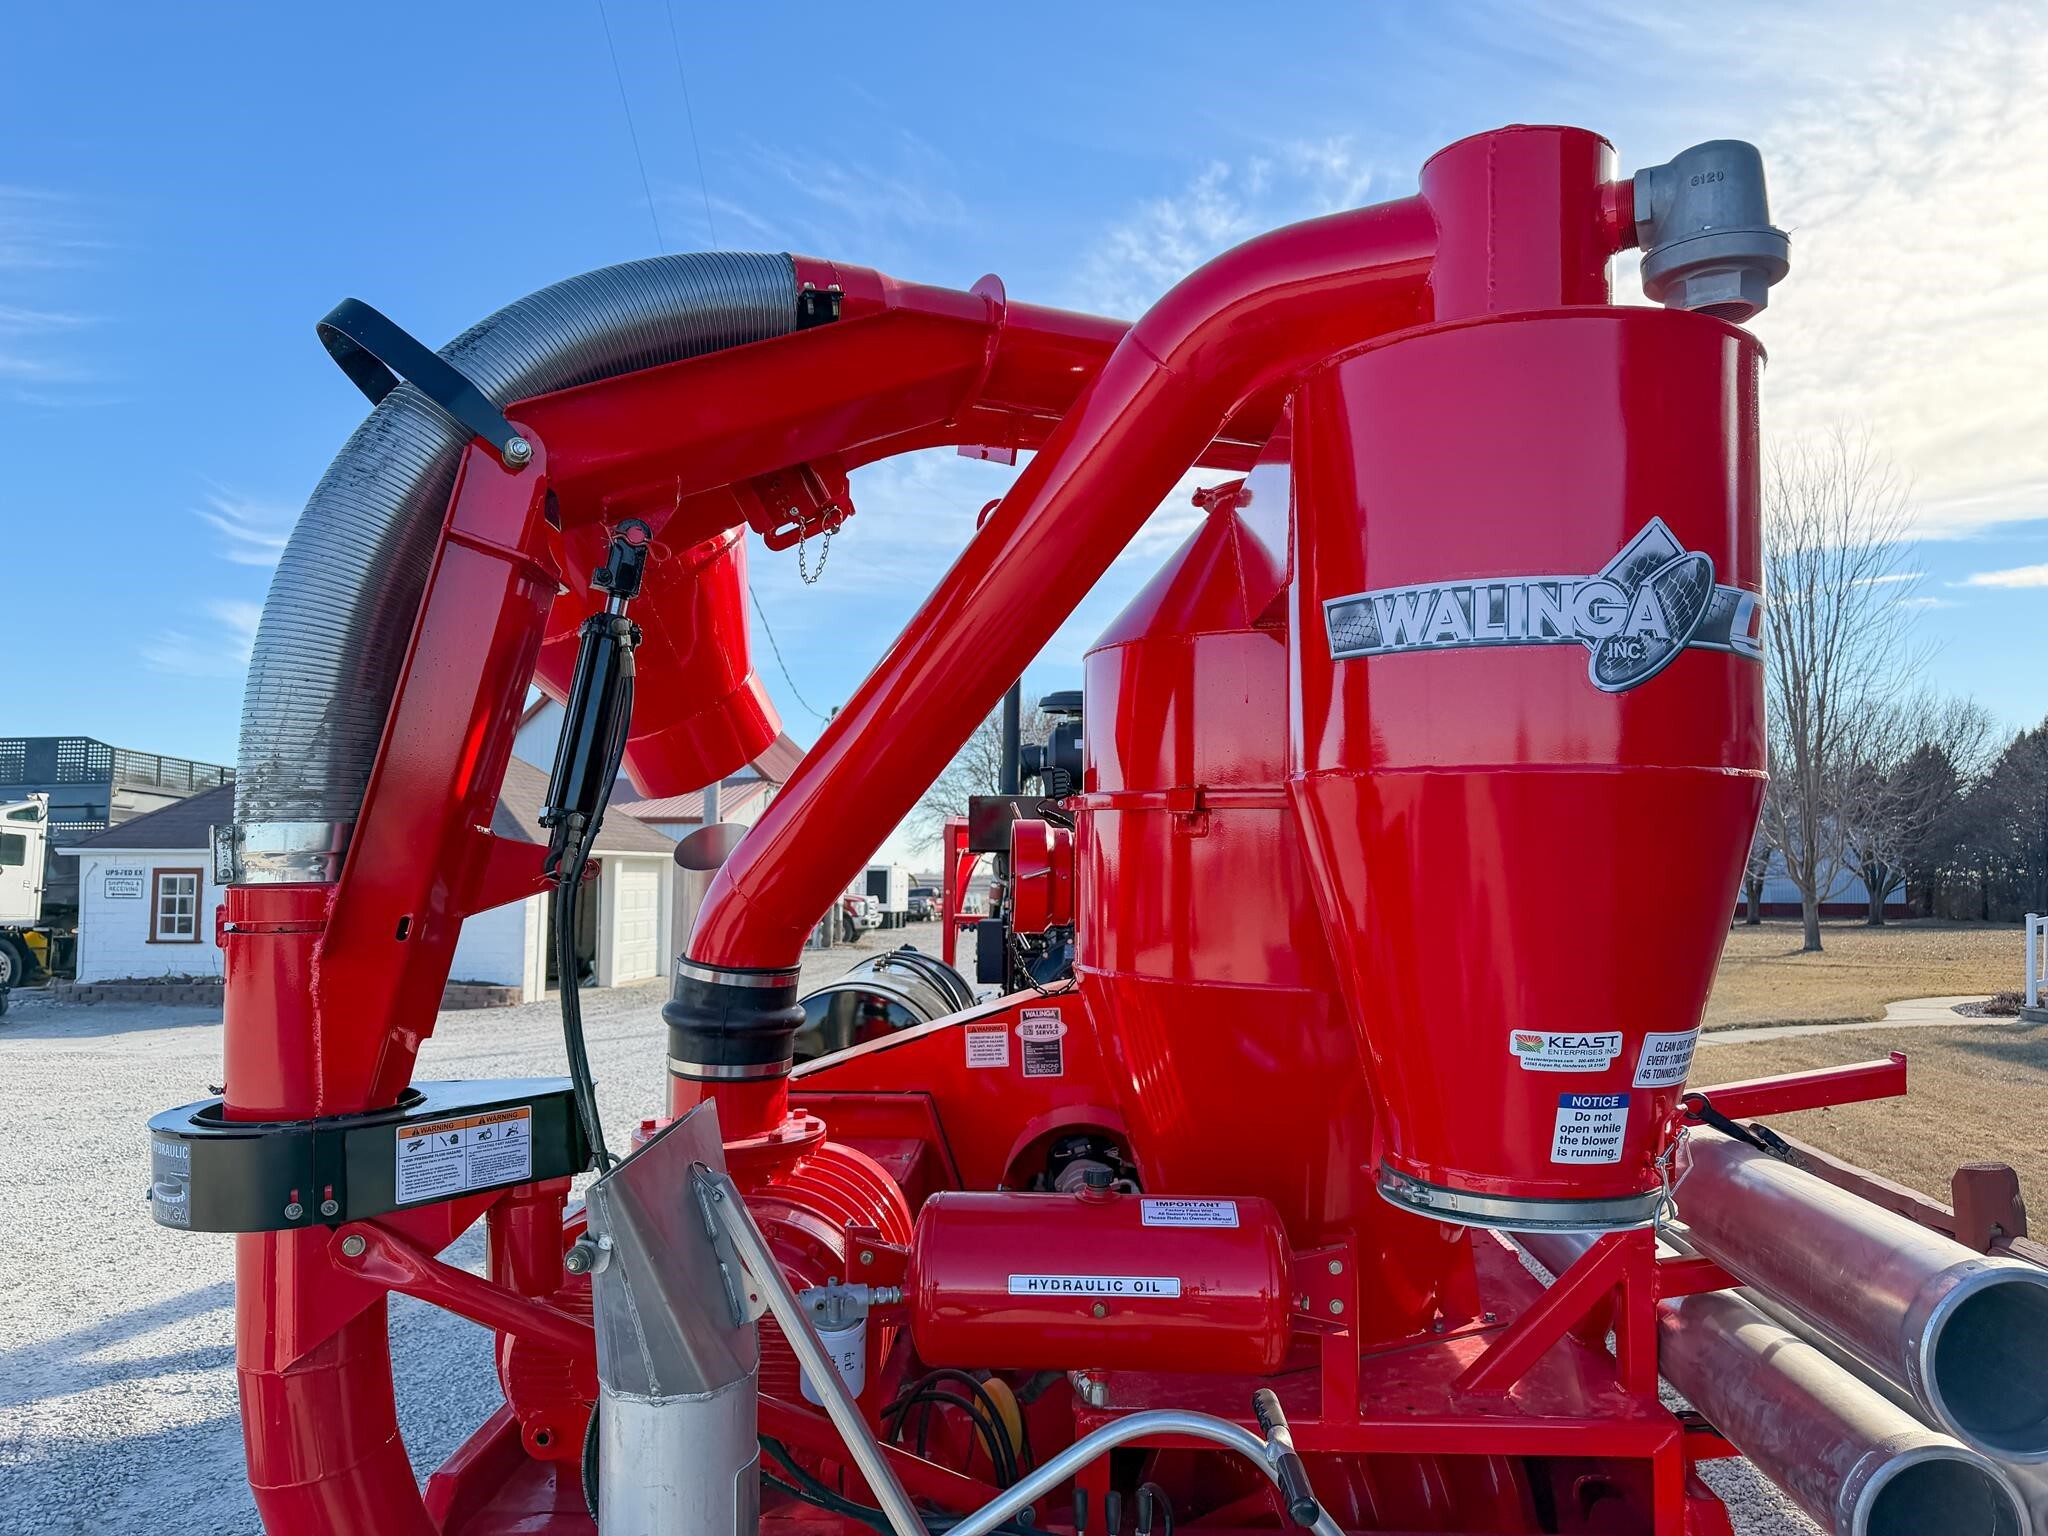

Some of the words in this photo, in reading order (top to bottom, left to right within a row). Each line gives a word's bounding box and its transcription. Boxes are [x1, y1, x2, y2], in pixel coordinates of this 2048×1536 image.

[1370, 578, 1672, 649] WALINGA
[1607, 642, 1647, 659] INC.
[1025, 1010, 1056, 1018] WALINGA
[1548, 1035, 1619, 1049] KEAST
[1655, 1040, 1677, 1053] CLEAN
[1677, 1039, 1687, 1051] OUT
[1547, 1048, 1603, 1056] ENTERPRISES
[1646, 1055, 1669, 1066] EVERY
[1638, 1068, 1651, 1081] (45
[1652, 1067, 1677, 1080] TONNES)
[1571, 1096, 1620, 1107] NOTICE
[486, 1111, 518, 1123] WARNING
[1574, 1111, 1591, 1122] Do
[1594, 1112, 1613, 1122] not
[421, 1122, 455, 1134] WARNING
[1560, 1124, 1590, 1135] open
[1593, 1123, 1622, 1134] while
[1559, 1135, 1579, 1145] the
[1581, 1136, 1619, 1146] blower
[1556, 1146, 1568, 1157] is
[1571, 1148, 1617, 1159] running.
[1028, 1279, 1123, 1292] HYDRAULIC
[1133, 1281, 1160, 1293] OIL
